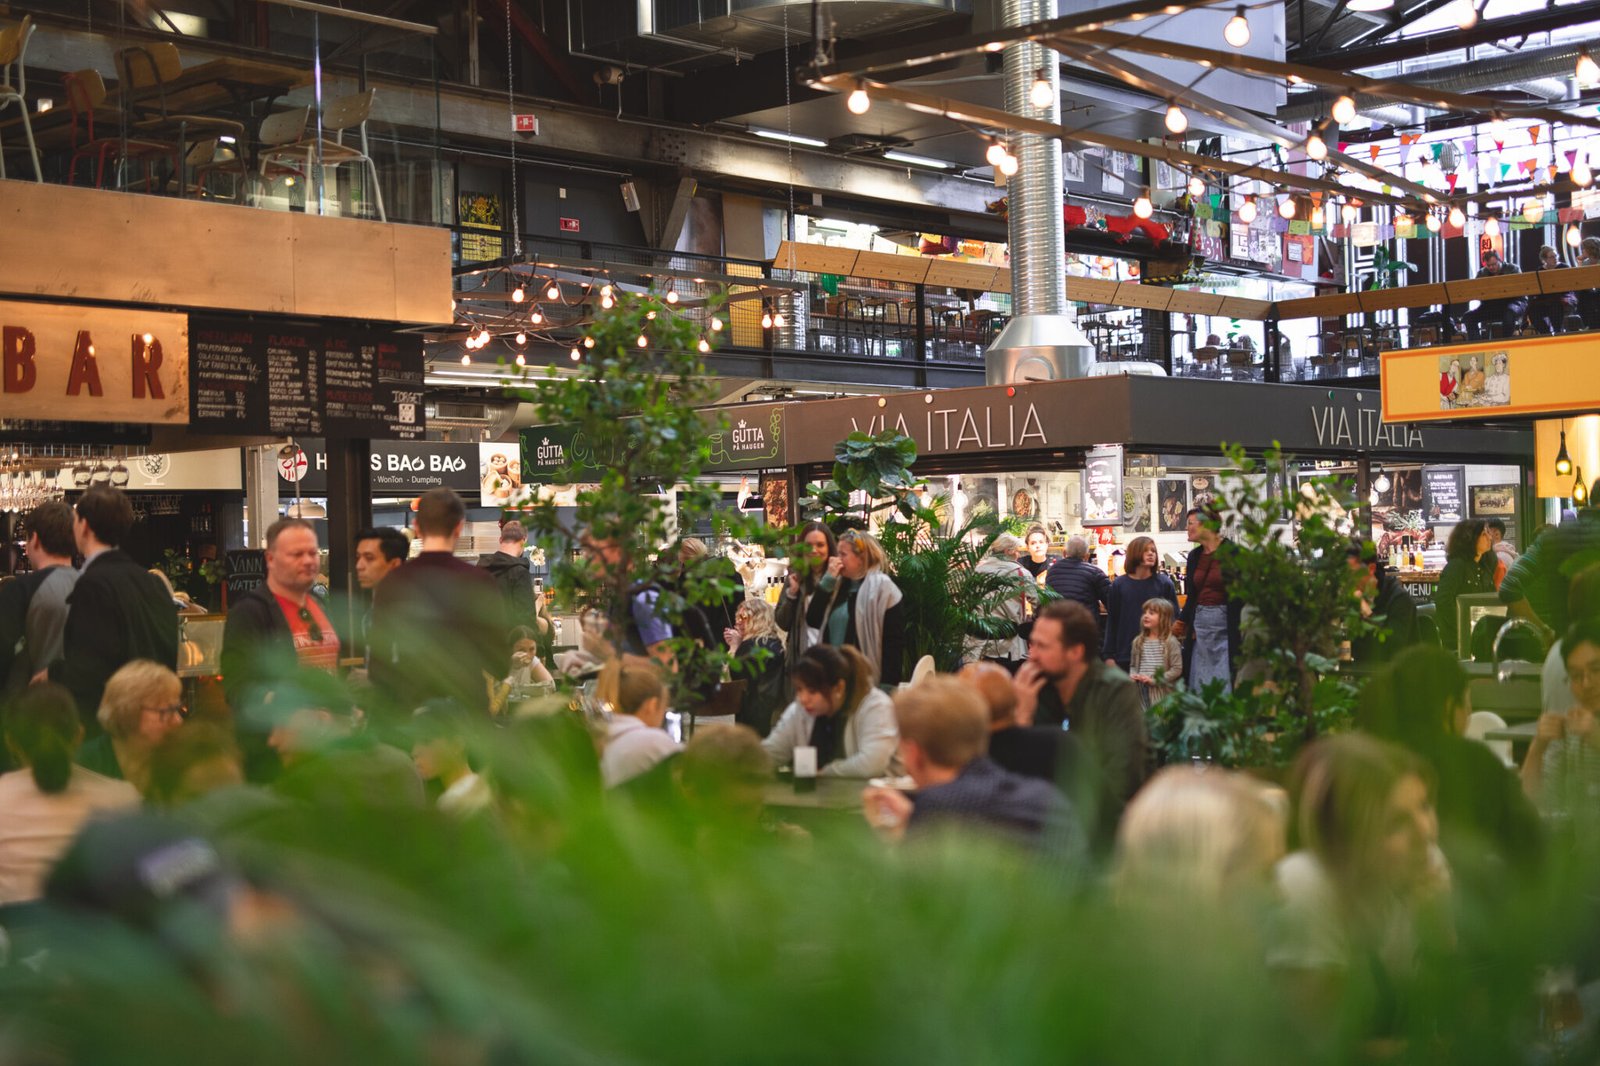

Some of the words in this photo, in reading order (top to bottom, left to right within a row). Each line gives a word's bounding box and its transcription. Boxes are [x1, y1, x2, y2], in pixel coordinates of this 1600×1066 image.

[3, 325, 165, 399] BAR
[392, 390, 424, 404] TORGET
[390, 424, 424, 432] MATHALLEN
[926, 396, 1048, 452] ITALIA
[1311, 405, 1353, 446] VIA
[1358, 407, 1424, 448] ITALIA
[732, 427, 765, 443] GUTTA
[537, 444, 564, 459] GUTTA
[741, 442, 765, 450] HAUGEN
[387, 453, 425, 472] BAO
[429, 454, 467, 473] BAO
[545, 458, 565, 466] HAUGEN
[411, 476, 442, 485] Dumpling
[228, 554, 263, 572] VANN
[1402, 583, 1432, 597] MENU
